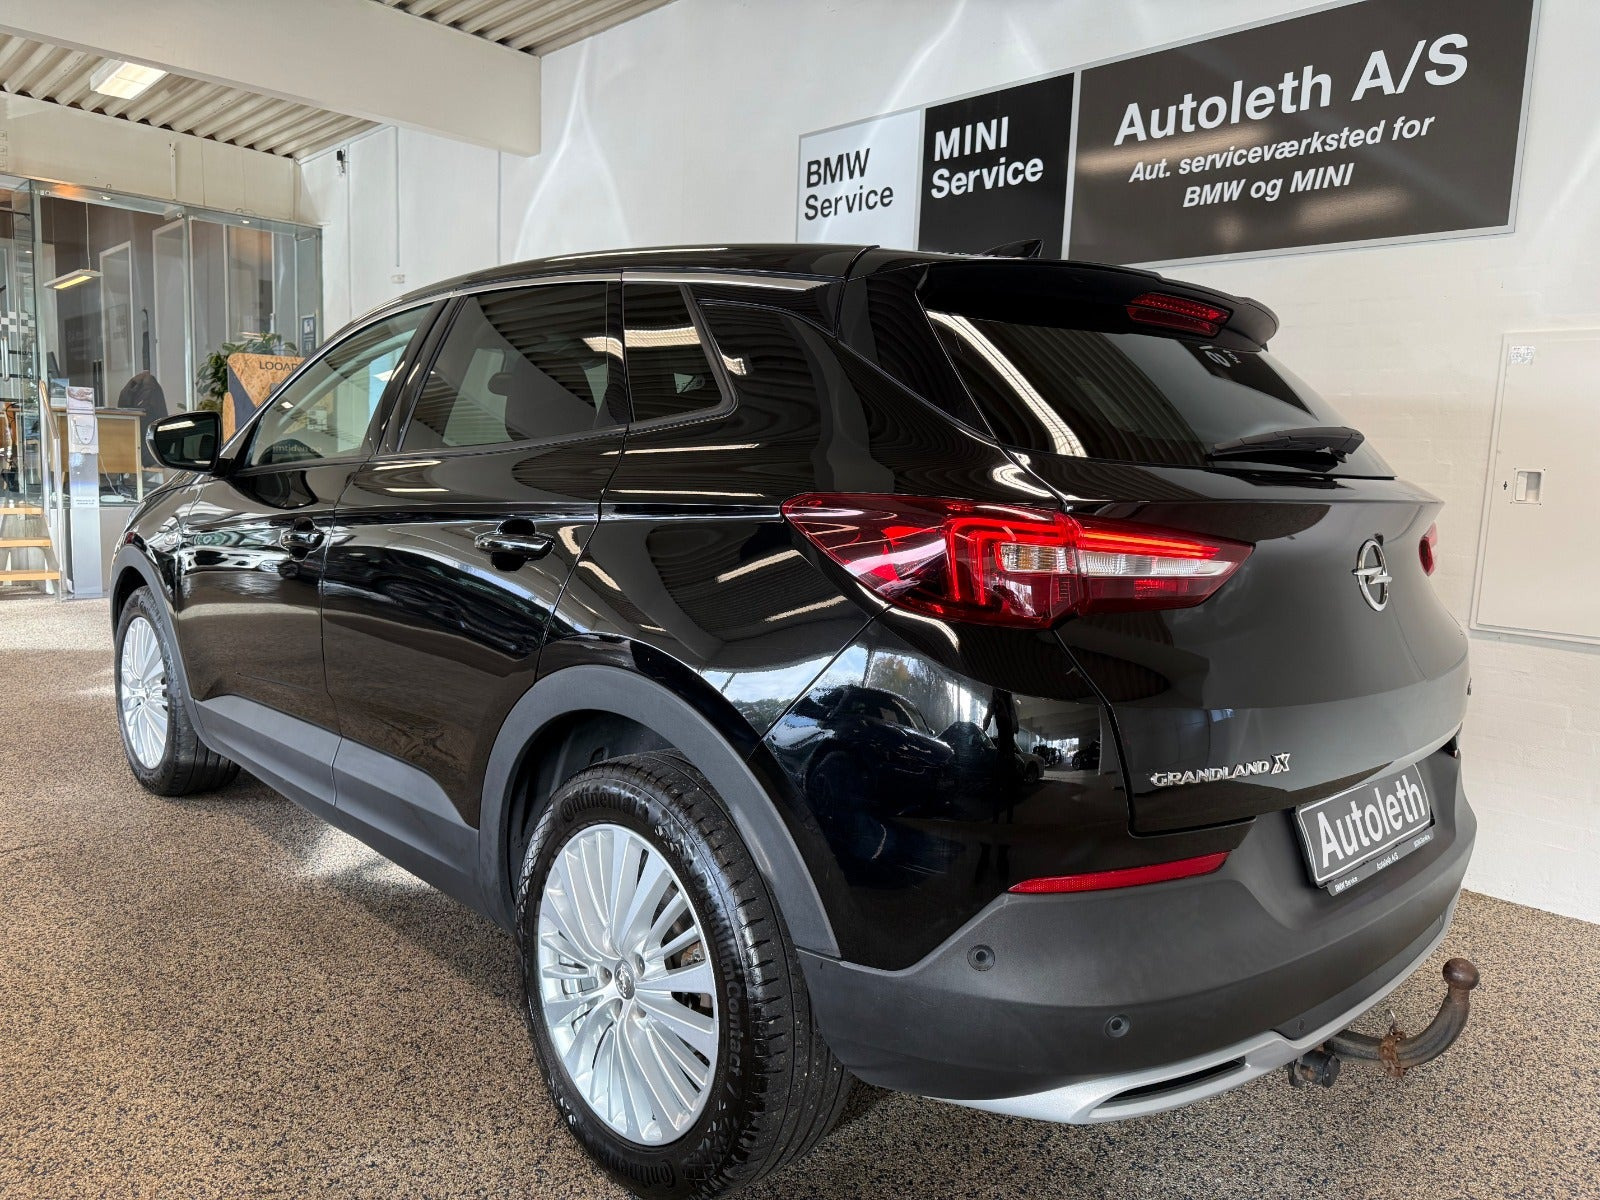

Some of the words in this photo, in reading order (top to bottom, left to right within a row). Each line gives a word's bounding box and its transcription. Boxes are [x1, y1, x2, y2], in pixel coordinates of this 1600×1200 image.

[1113, 65, 1332, 146] Autoleth
[1350, 33, 1469, 102] A/S
[934, 116, 1009, 162] MINI
[1128, 159, 1171, 183] Aut.
[1178, 120, 1386, 176] serviceværksted
[1391, 115, 1435, 142] for
[806, 148, 871, 189] BMW
[931, 157, 1044, 199] Service
[1183, 179, 1245, 208] BMW
[1250, 176, 1284, 202] og
[1289, 162, 1355, 194] MINI
[804, 185, 894, 221] Service
[1150, 760, 1270, 787] GRANDLAND
[1317, 774, 1425, 868] Autoleth
